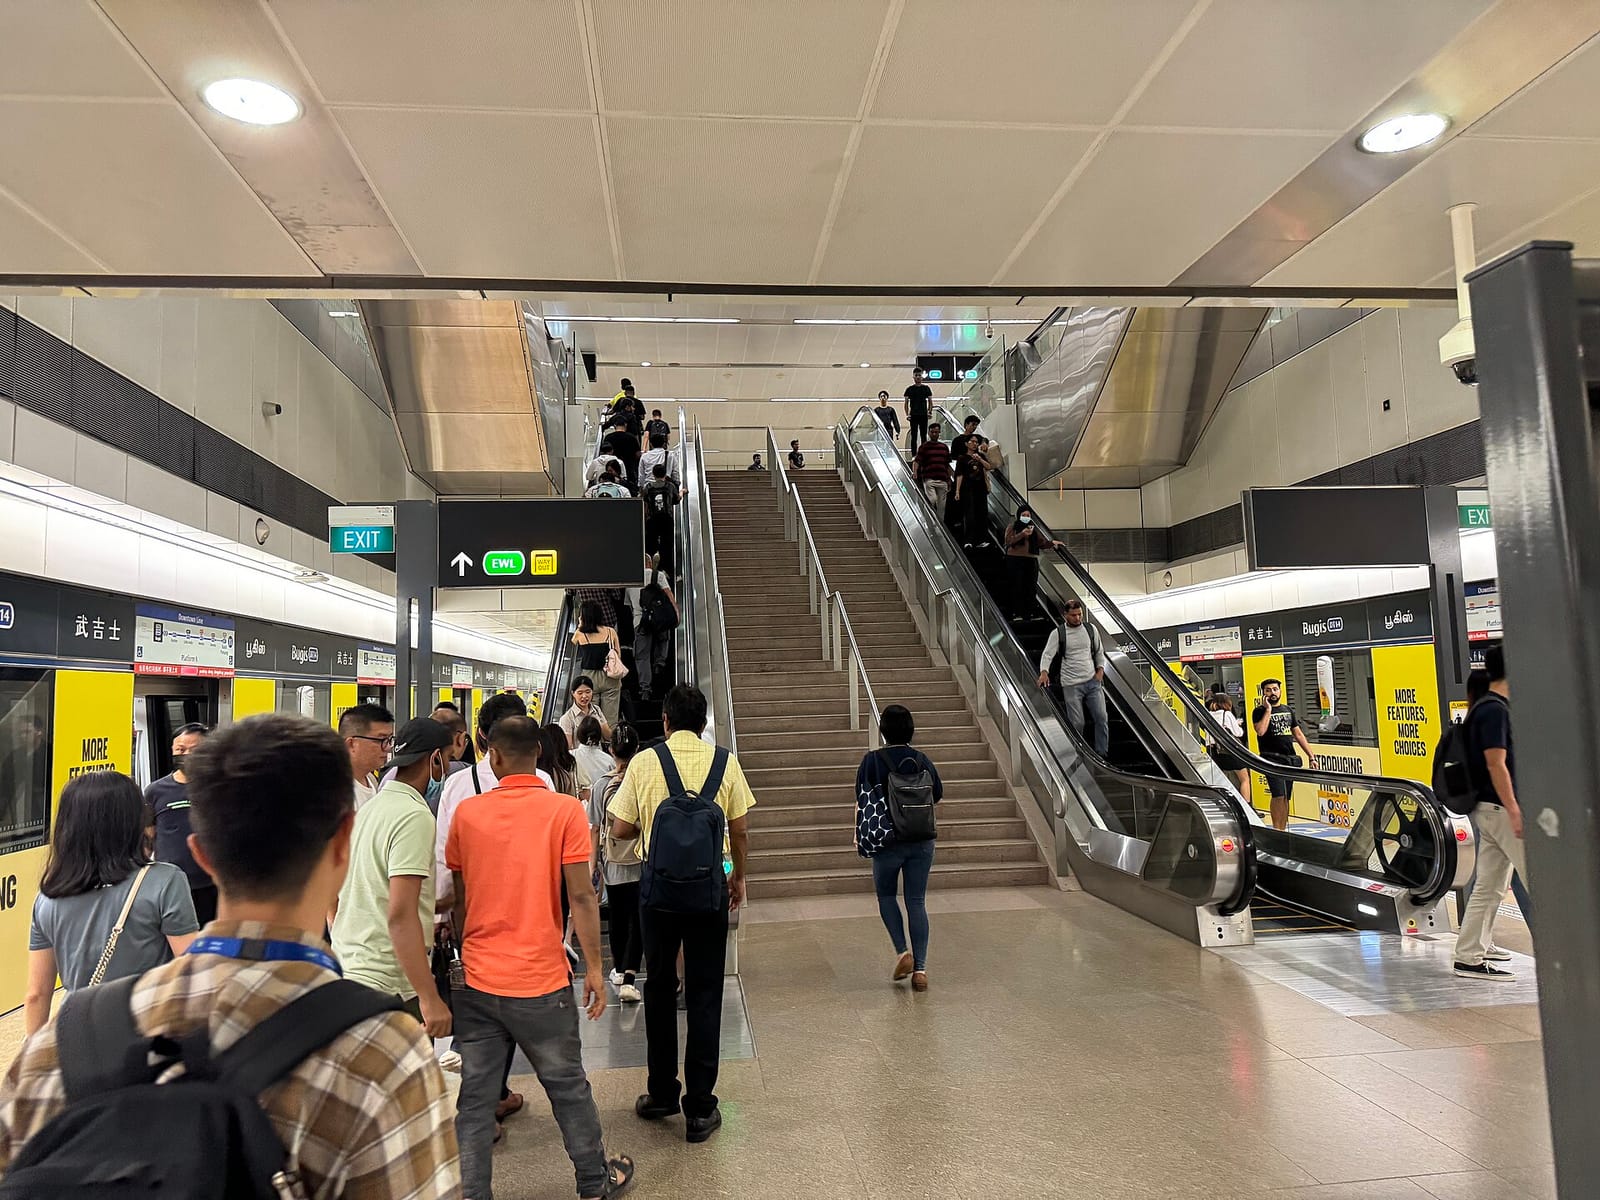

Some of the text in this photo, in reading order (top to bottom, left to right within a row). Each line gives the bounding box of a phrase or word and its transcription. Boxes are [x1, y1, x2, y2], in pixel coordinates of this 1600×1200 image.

[1468, 508, 1491, 525] EXI
[343, 530, 381, 549] EXIT
[491, 558, 517, 569] EWL
[75, 614, 121, 641] 武吉士
[1248, 625, 1273, 641] 武吉士
[1302, 619, 1327, 637] Bugis
[291, 644, 308, 665] Bugis
[1394, 688, 1416, 704] MORE
[1387, 706, 1428, 725] FEATURES,
[1397, 723, 1420, 739] MORE
[82, 737, 109, 762] MORE
[1394, 740, 1427, 757] CHOICES
[1314, 754, 1363, 774] TRODUCING
